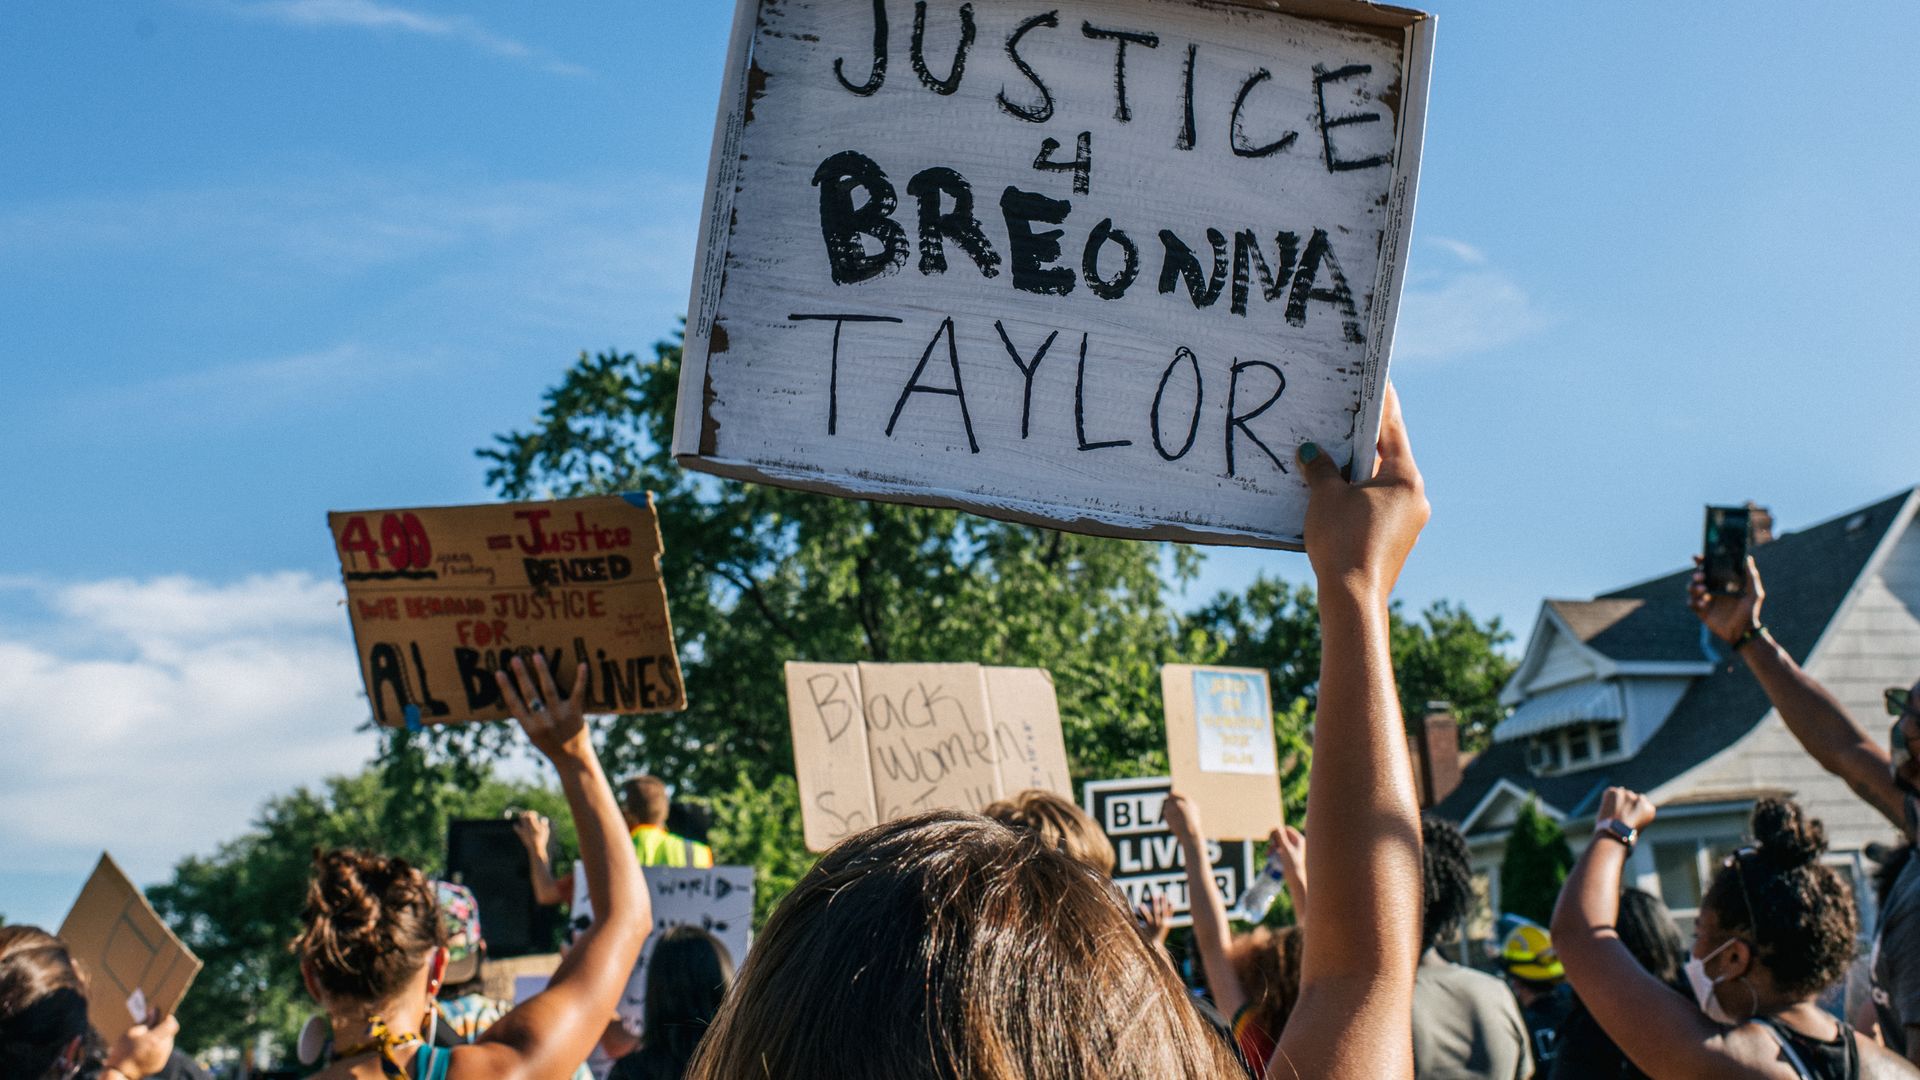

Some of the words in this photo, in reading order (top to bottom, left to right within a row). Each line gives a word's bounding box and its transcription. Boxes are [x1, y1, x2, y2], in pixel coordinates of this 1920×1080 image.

[833, 0, 1393, 173] JUSTICE
[1033, 131, 1092, 195] 4
[811, 150, 1364, 344] BREONNA
[787, 313, 1288, 477] TAYLOR
[340, 511, 433, 571] 400
[456, 619, 511, 647] FOR
[490, 589, 607, 620] JUSTICE
[806, 671, 974, 743] Black
[1120, 873, 1229, 906] ATTR
